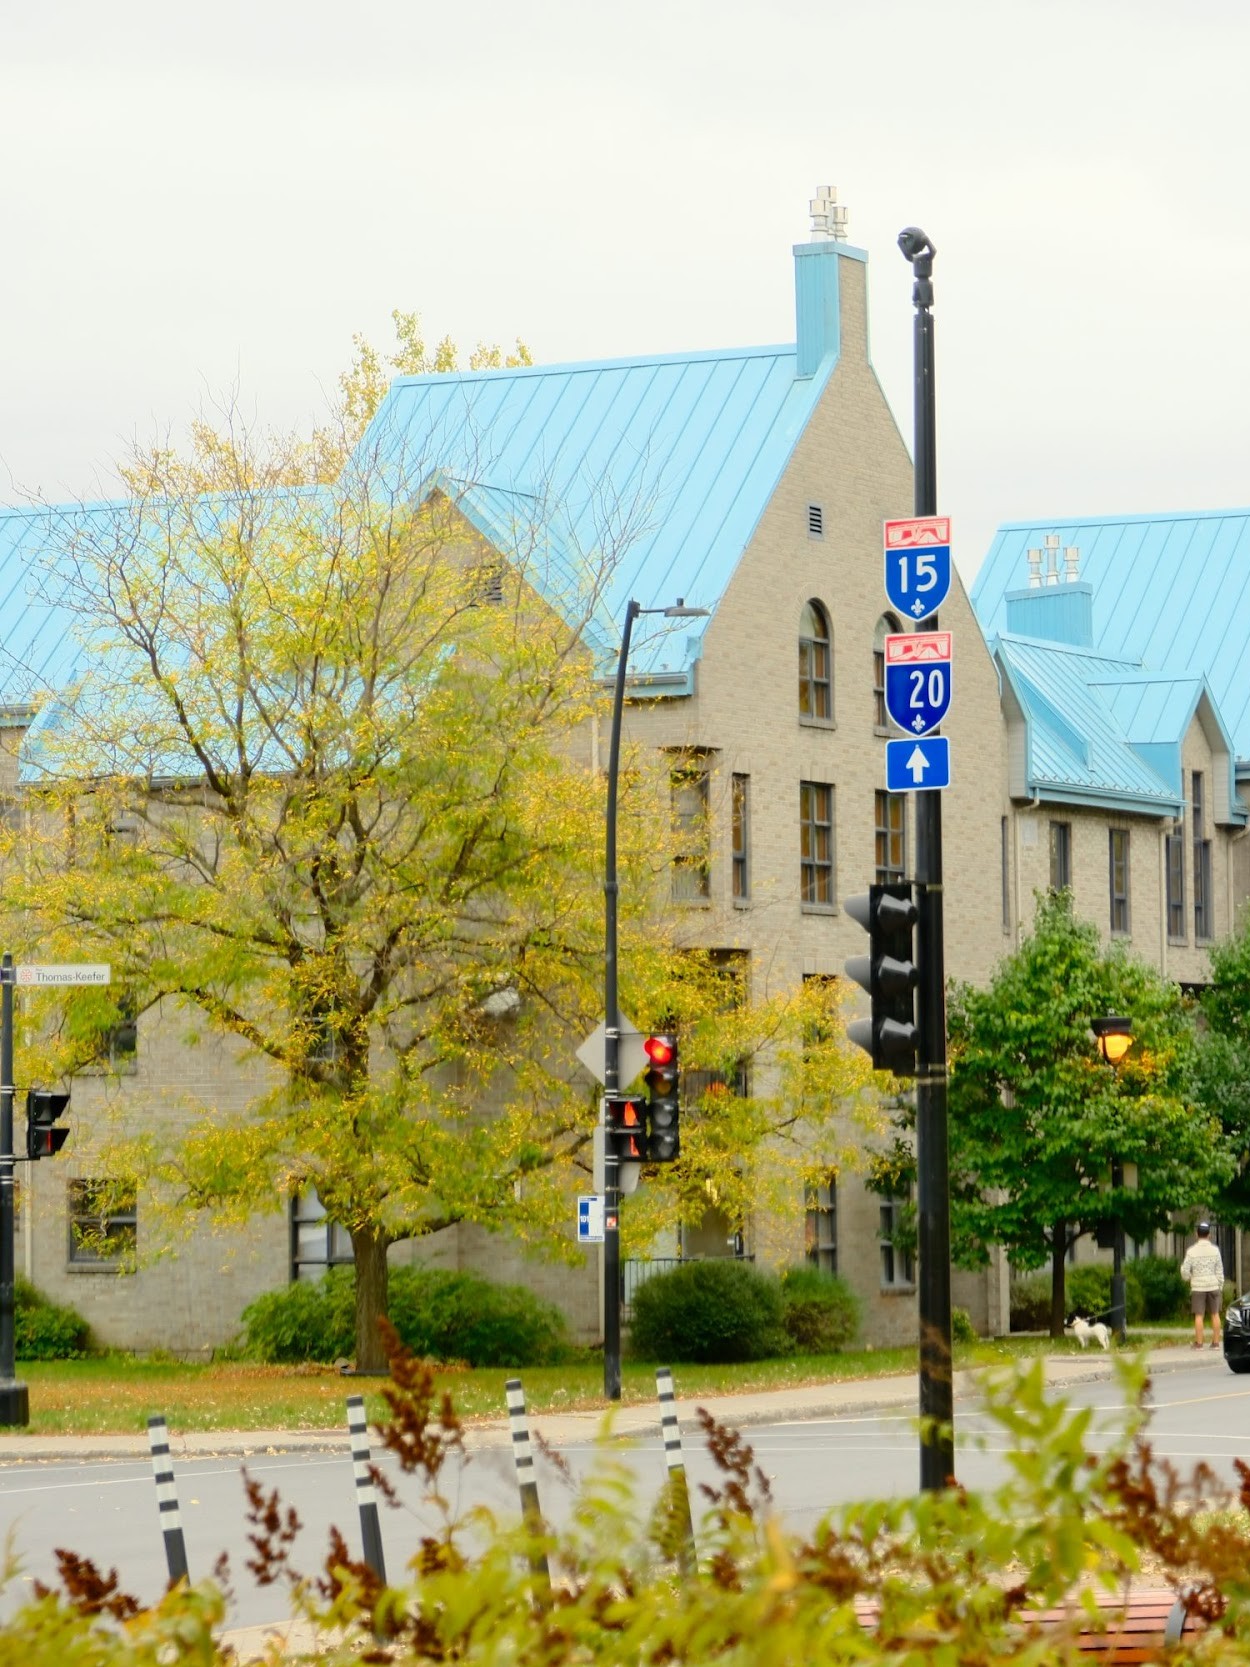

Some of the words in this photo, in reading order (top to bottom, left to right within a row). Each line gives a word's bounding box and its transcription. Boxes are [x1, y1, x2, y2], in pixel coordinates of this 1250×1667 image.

[898, 554, 938, 593] 15
[909, 669, 944, 708] 20
[36, 971, 105, 982] Thomas-Keefer
